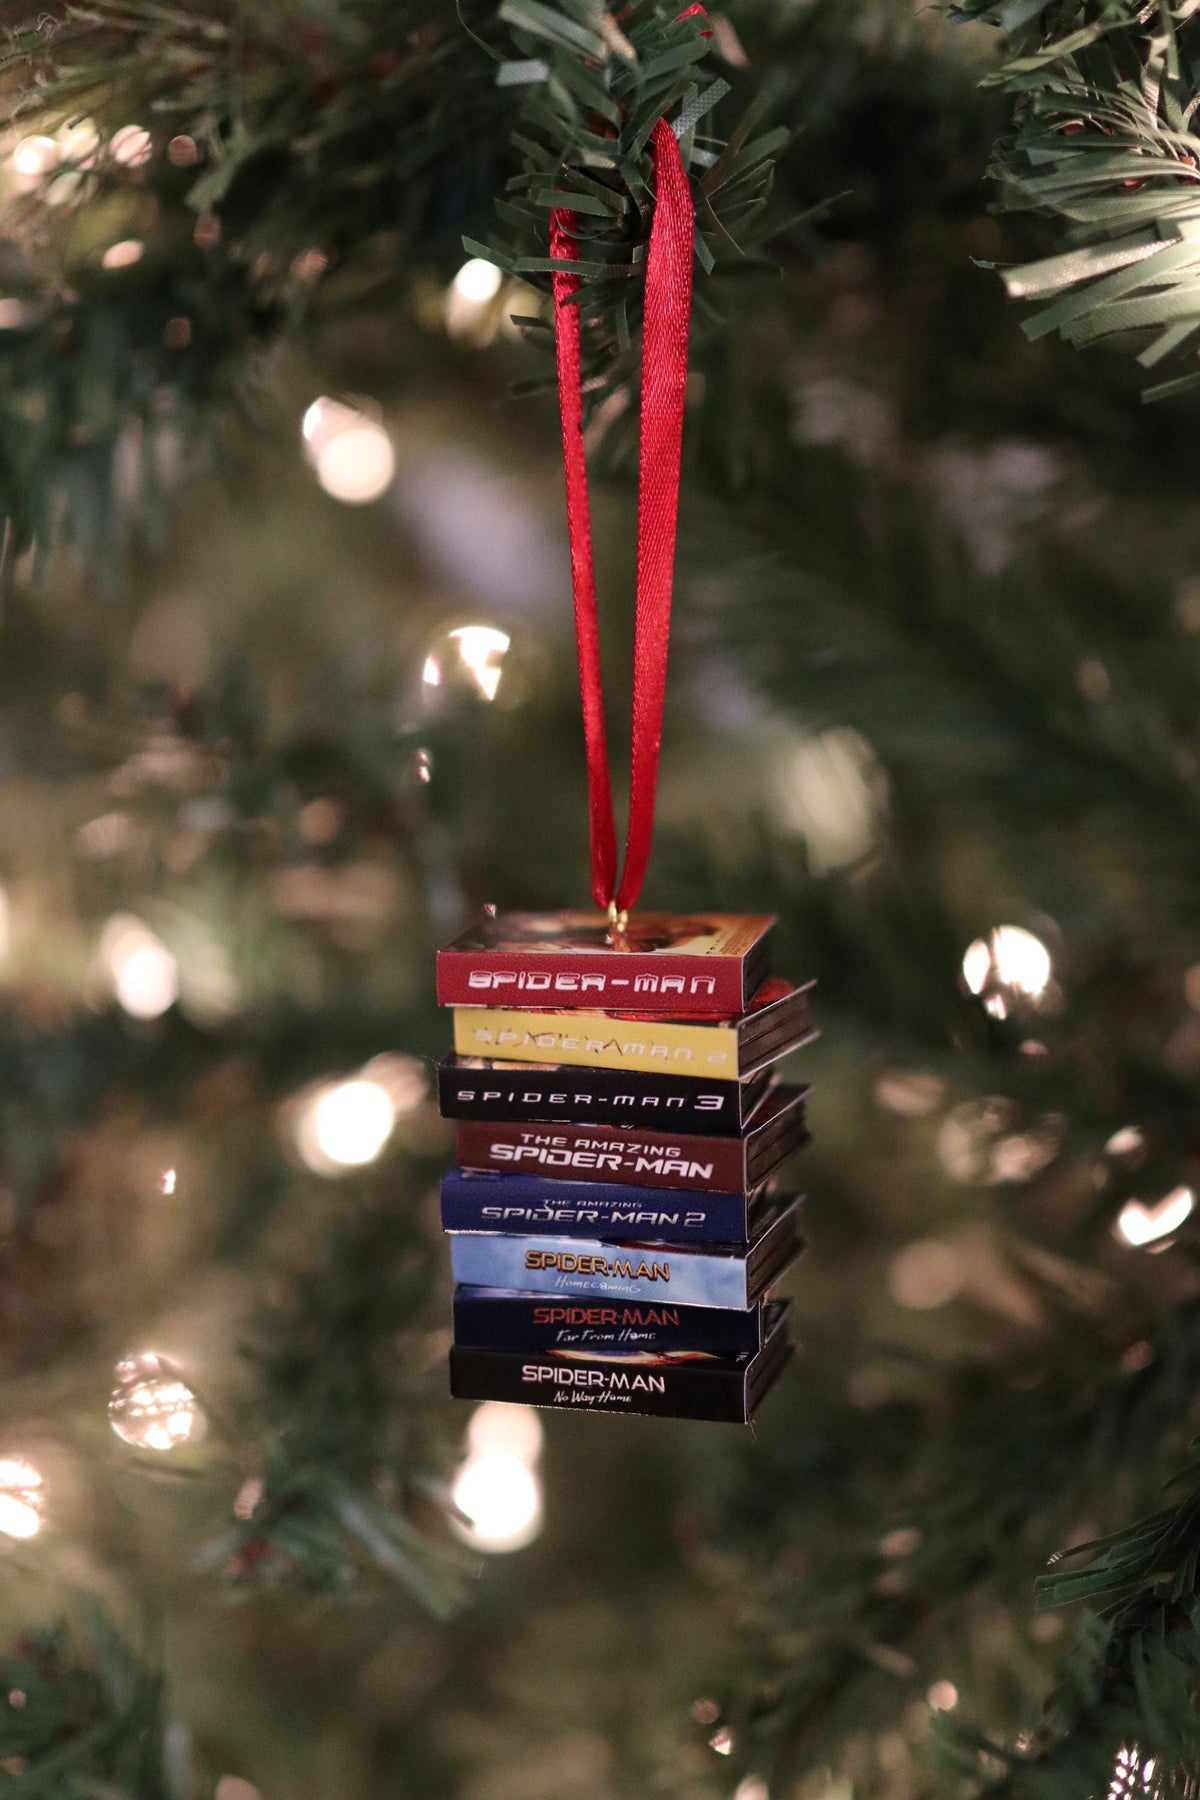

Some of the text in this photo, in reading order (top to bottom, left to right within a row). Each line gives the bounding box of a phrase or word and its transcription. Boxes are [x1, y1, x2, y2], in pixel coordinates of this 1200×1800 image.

[468, 971, 716, 995] SPIDER-MAN
[457, 1090, 724, 1110] SPIDER-MAN 3
[520, 1133, 681, 1157] THE AMAZING
[490, 1144, 713, 1179] SPIDER-MAN
[576, 1200, 643, 1209] AMAZING
[481, 1206, 706, 1228] SPIDER-MAN 2
[525, 1250, 670, 1282] SPIDER-MAN
[533, 1307, 680, 1326] SPIDER-MAN
[556, 1328, 579, 1342] Far
[581, 1329, 614, 1341] From
[521, 1365, 666, 1393] SPIDER-MAN
[553, 1390, 569, 1403] No
[571, 1390, 595, 1405] Way
